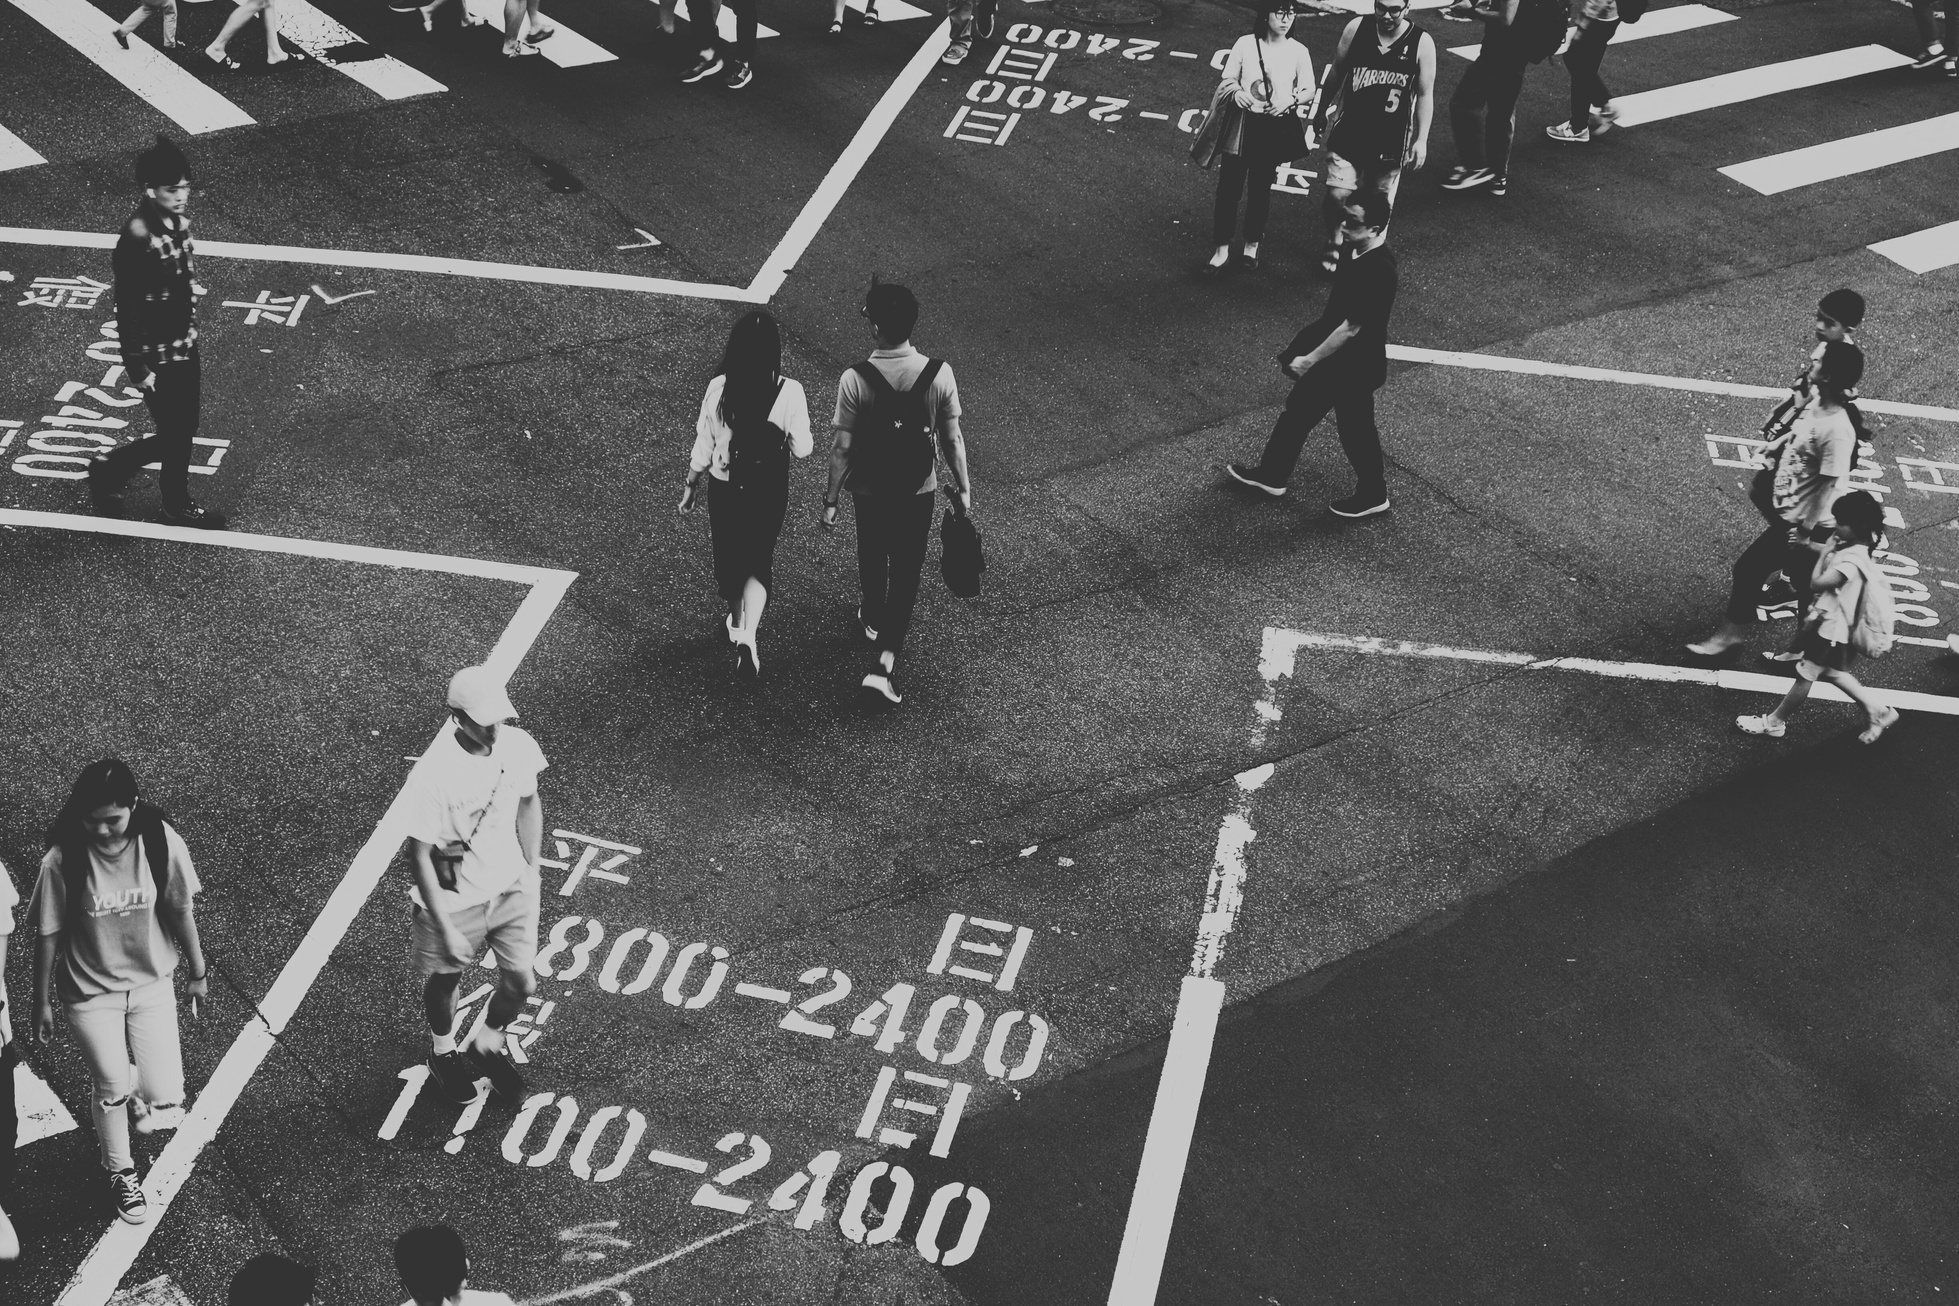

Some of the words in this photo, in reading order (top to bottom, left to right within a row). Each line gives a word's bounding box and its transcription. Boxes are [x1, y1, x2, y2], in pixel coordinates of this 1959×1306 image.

[985, 45, 1058, 82] 日
[1352, 66, 1409, 92] WARRIORS
[1384, 88, 1402, 113] 5
[943, 105, 1021, 146] 日
[221, 289, 310, 327] 平
[538, 828, 642, 896] 平
[927, 913, 1034, 992] 日
[480, 915, 1050, 1081] 800-2400
[855, 1066, 972, 1159] 日
